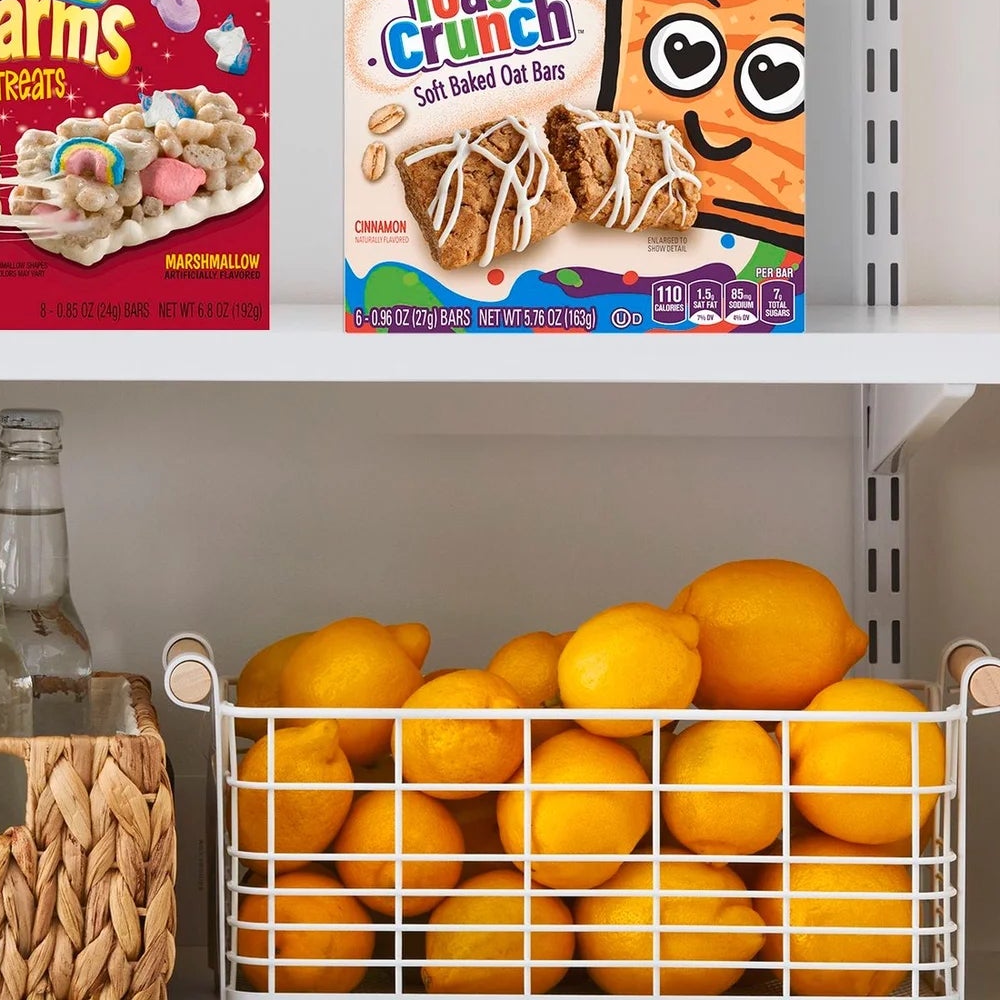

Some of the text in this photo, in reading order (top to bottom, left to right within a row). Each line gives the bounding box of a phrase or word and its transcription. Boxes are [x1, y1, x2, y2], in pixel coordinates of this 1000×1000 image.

[414, 61, 566, 107] Soft Baked Oat Bars
[355, 220, 406, 233] CINNAMON
[165, 253, 260, 270] MARSHMALLOW
[164, 270, 261, 280] ARTIFICIALLY FLAVORED
[756, 267, 793, 277] PER BAR
[657, 285, 682, 302] 110
[654, 303, 684, 312] CALORIES
[693, 301, 718, 309] SAT FAT
[729, 301, 754, 309] SODIUM
[768, 301, 787, 309] TOTAL
[40, 303, 46, 318] 8
[56, 303, 77, 318] 0.85
[81, 303, 94, 318] OZ
[97, 302, 121, 322] (24g)
[124, 303, 149, 318] BARS
[158, 303, 178, 318] NET
[179, 303, 195, 318] WT
[198, 303, 213, 318] 6.8
[216, 303, 229, 318] OZ
[232, 302, 263, 322] (192g)
[765, 309, 791, 317] SUGARS
[355, 309, 362, 326] 6
[372, 309, 392, 326] 0.96
[395, 309, 409, 326] OZ
[412, 308, 438, 329] (27g)
[440, 309, 470, 326] BARS
[479, 309, 500, 326] NET
[503, 309, 522, 326] WT
[524, 309, 545, 326] 5.76
[548, 309, 562, 326] OZ
[564, 308, 596, 329] (163g)
